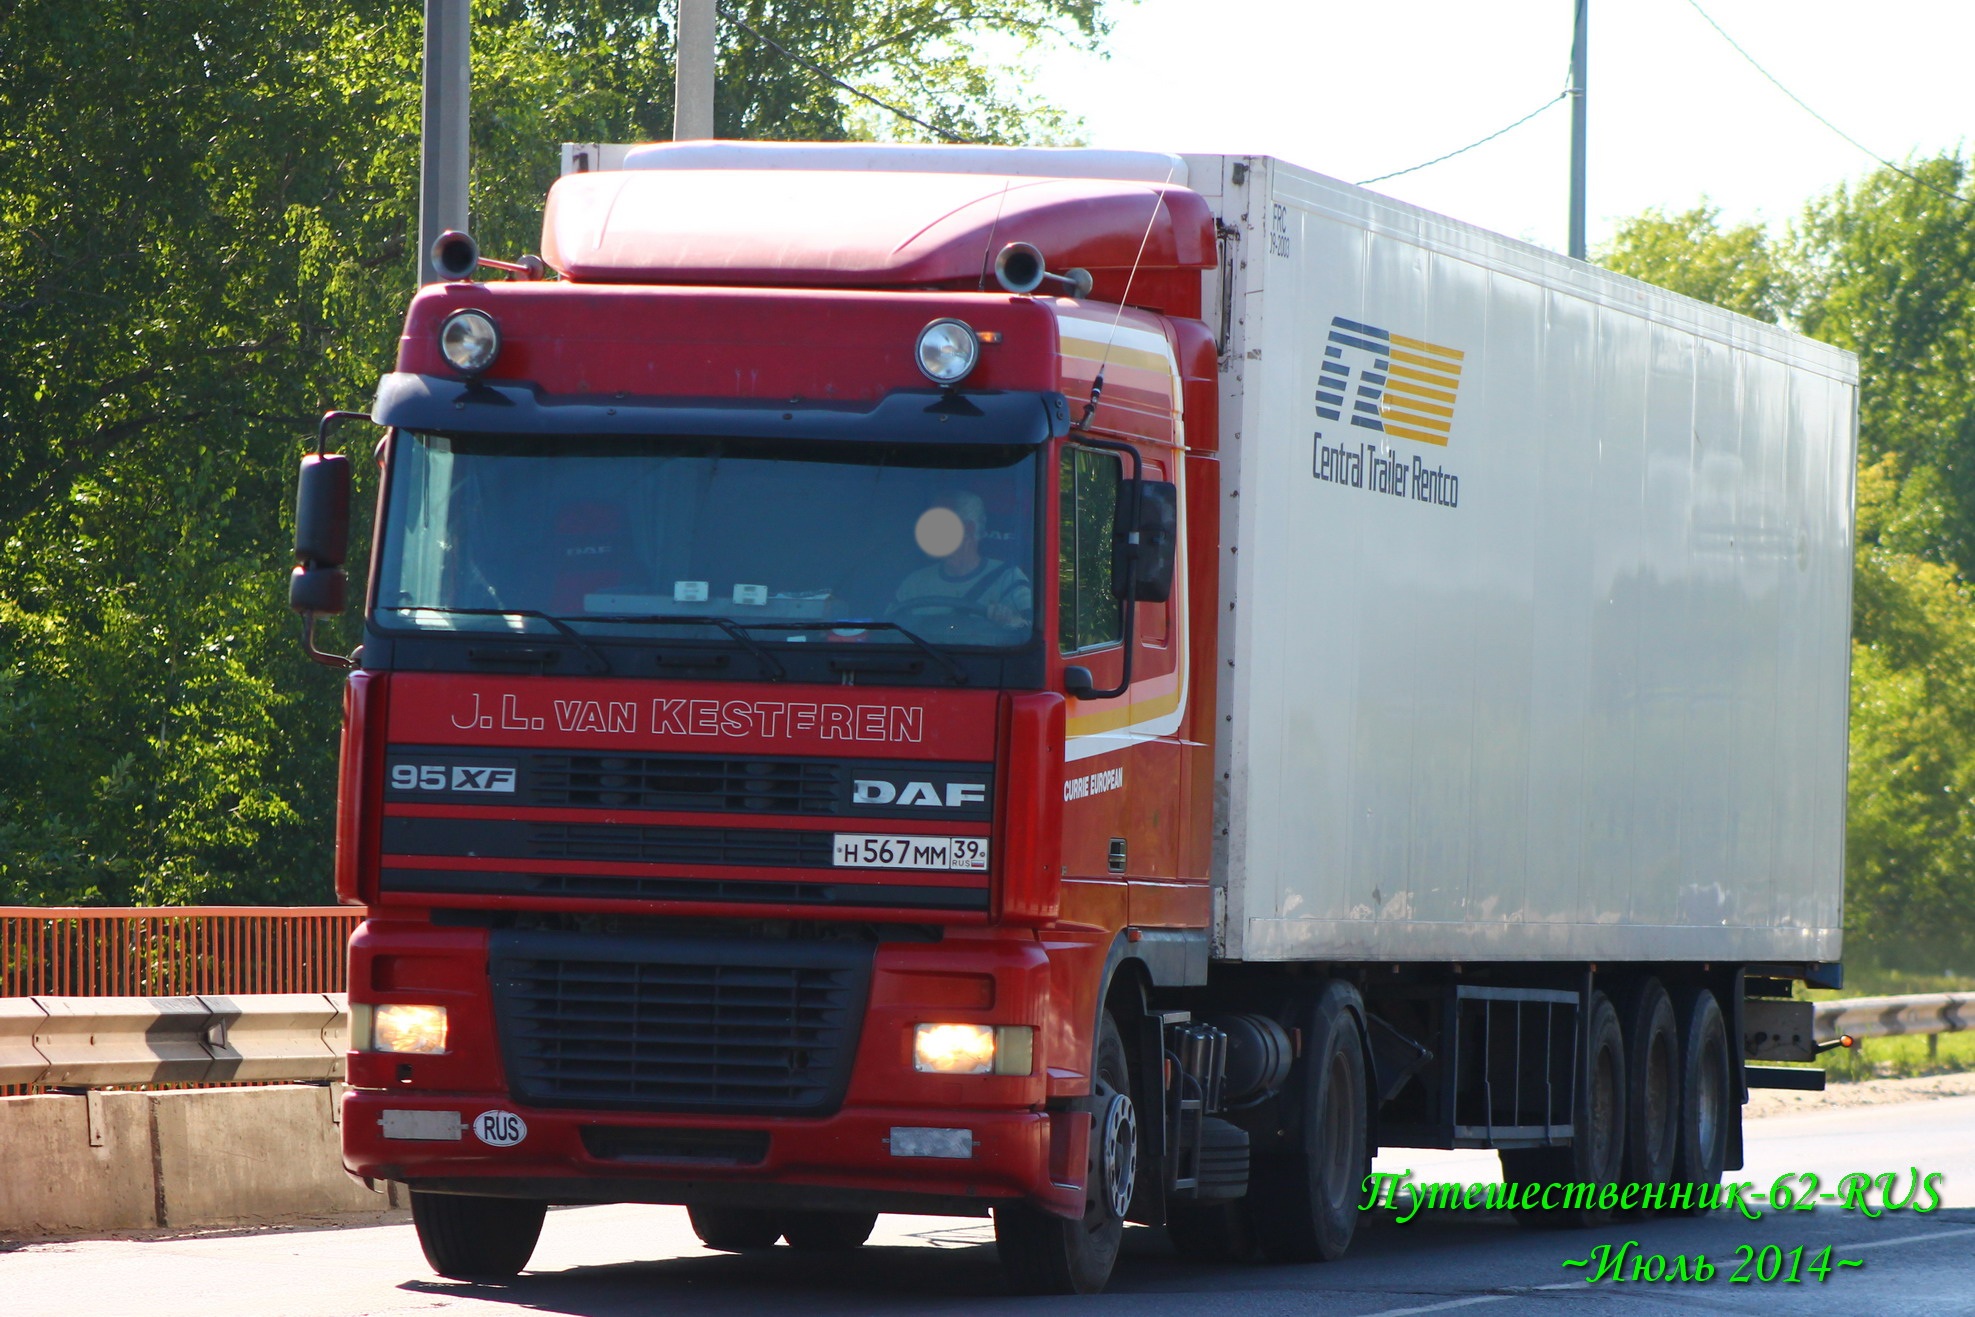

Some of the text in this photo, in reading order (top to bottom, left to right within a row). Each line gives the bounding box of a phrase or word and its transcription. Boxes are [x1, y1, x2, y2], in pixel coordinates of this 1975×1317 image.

[1273, 203, 1287, 233] FRC
[1312, 431, 1459, 508] Central Trailer Rentco
[553, 700, 637, 733] VAN
[852, 779, 986, 807] DAF
[1063, 766, 1123, 802] CURRIE EUROPEAN
[952, 859, 971, 868] RUS
[953, 840, 979, 859] 39
[484, 1115, 520, 1141] RUS
